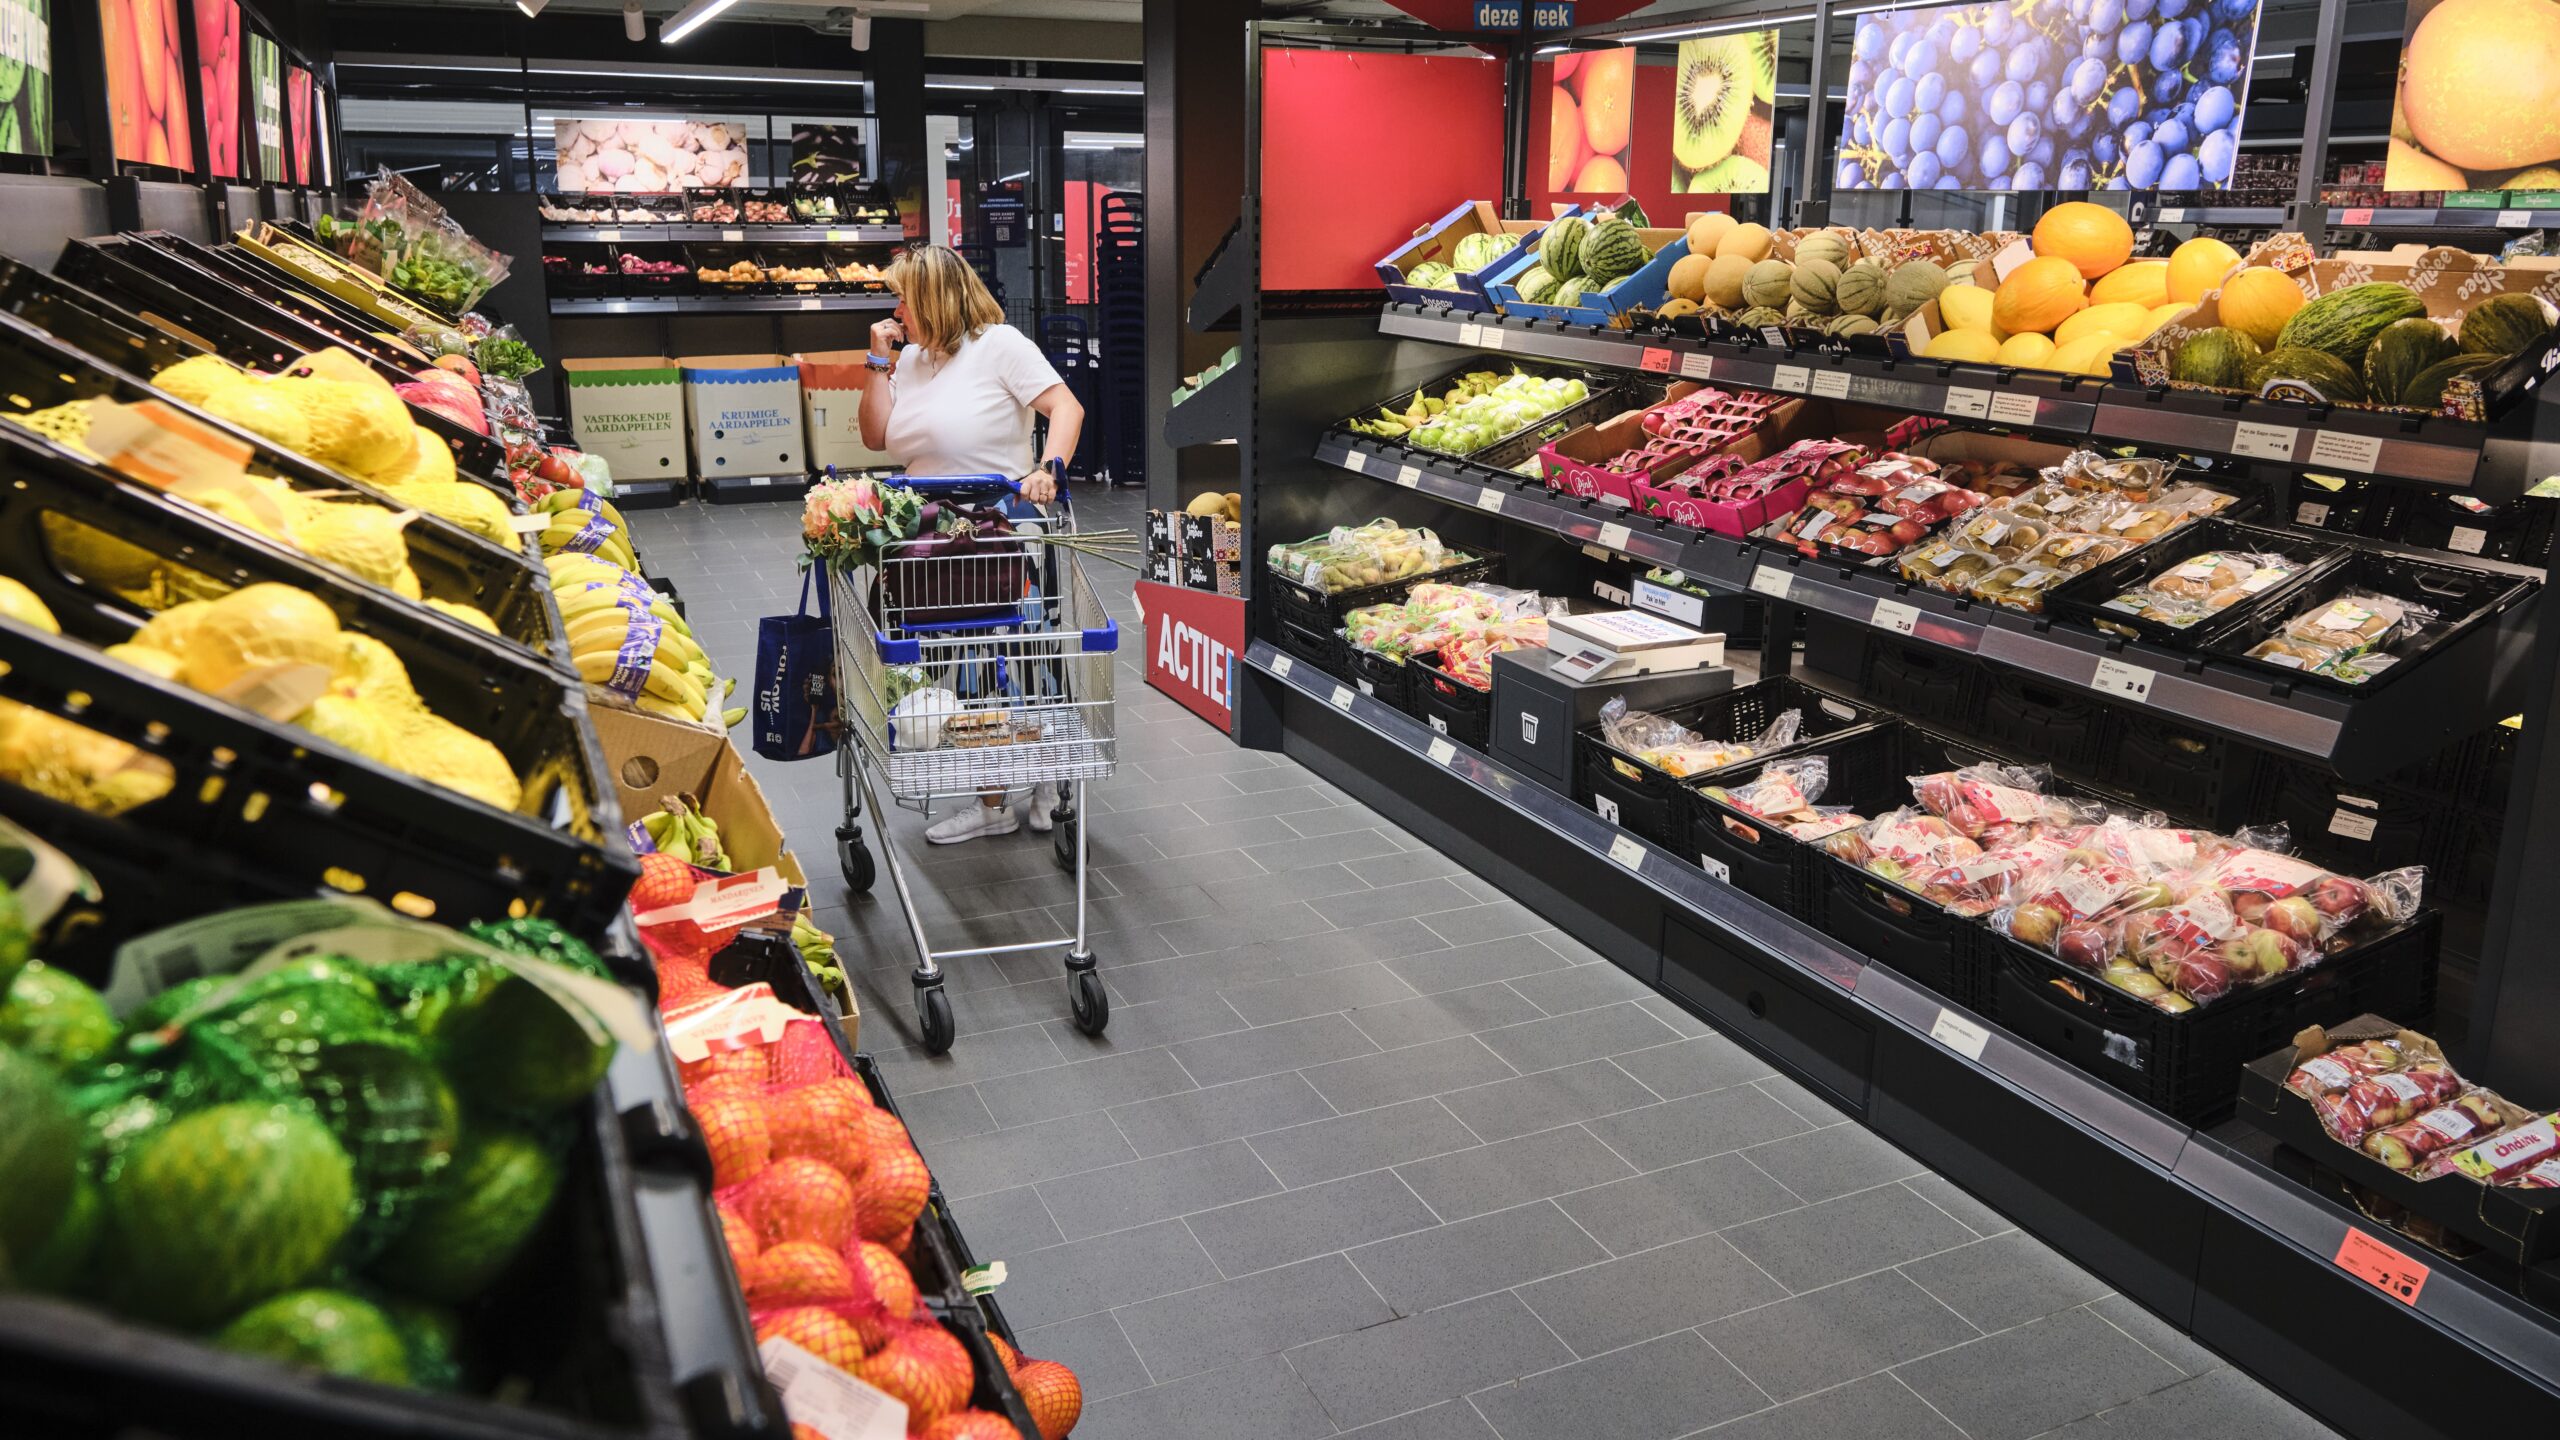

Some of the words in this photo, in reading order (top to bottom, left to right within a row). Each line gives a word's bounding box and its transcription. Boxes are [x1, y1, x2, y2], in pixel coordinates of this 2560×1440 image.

[1480, 4, 1519, 27] deze
[583, 411, 672, 425] VASTKOKENDE
[721, 408, 779, 420] KRUIMIGE
[584, 420, 671, 433] AARDAPPELEN
[709, 417, 791, 430] AARDAPPELEN
[1576, 476, 1594, 491] Pink
[1674, 507, 1696, 525] Pink
[772, 645, 787, 714] FOLLOW
[760, 690, 771, 712] US
[710, 885, 765, 904] MANDARIJNEN
[2495, 1132, 2542, 1158] Ondine
